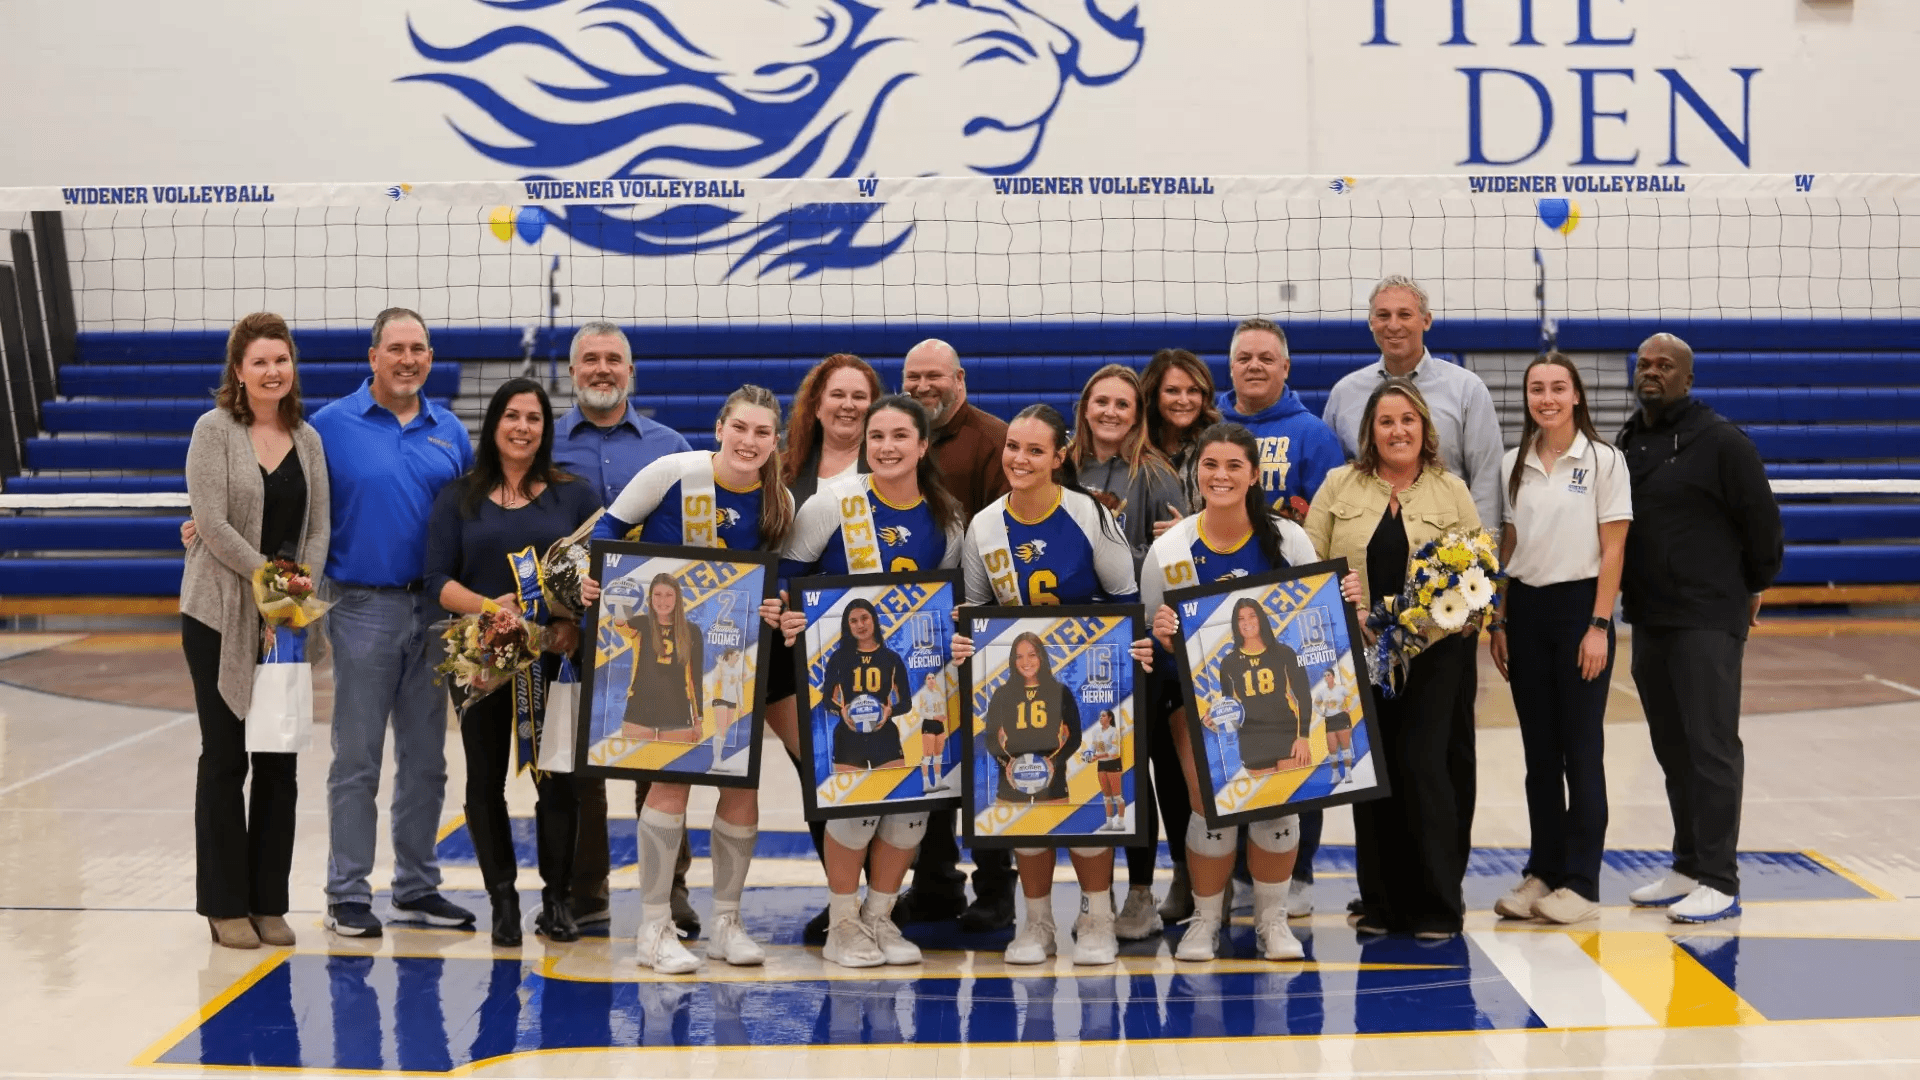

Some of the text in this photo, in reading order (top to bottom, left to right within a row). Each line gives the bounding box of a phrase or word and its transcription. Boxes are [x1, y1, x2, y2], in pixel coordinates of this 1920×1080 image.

[1454, 67, 1764, 168] DEN
[525, 180, 744, 200] WIDENER VOLLEYBALL
[858, 179, 879, 197] W
[993, 177, 1214, 195] WIDENER VOLLEYBALL
[1469, 175, 1686, 193] WIDENER VOLLEYBALL
[1795, 174, 1815, 192] W
[62, 185, 274, 204] WIDENER VOLLEYBALL
[1572, 467, 1590, 485] W
[841, 495, 877, 571] SEN
[606, 553, 622, 568] W
[805, 592, 821, 606] W
[717, 591, 736, 628] 2
[1183, 602, 1198, 617] W
[910, 613, 935, 649] 10
[973, 618, 989, 632] W
[1298, 610, 1325, 647] 18
[707, 632, 741, 646] TOOMEY
[861, 656, 872, 664] W
[908, 655, 941, 668] VERCHIO
[1086, 646, 1112, 684] 16
[1249, 658, 1260, 667] W
[1296, 649, 1337, 667] RICEVUTO
[853, 667, 881, 692] 10
[1242, 668, 1274, 697] 18
[1026, 690, 1037, 700] W
[1082, 690, 1114, 703] HERRIN
[1016, 701, 1047, 729] 16
